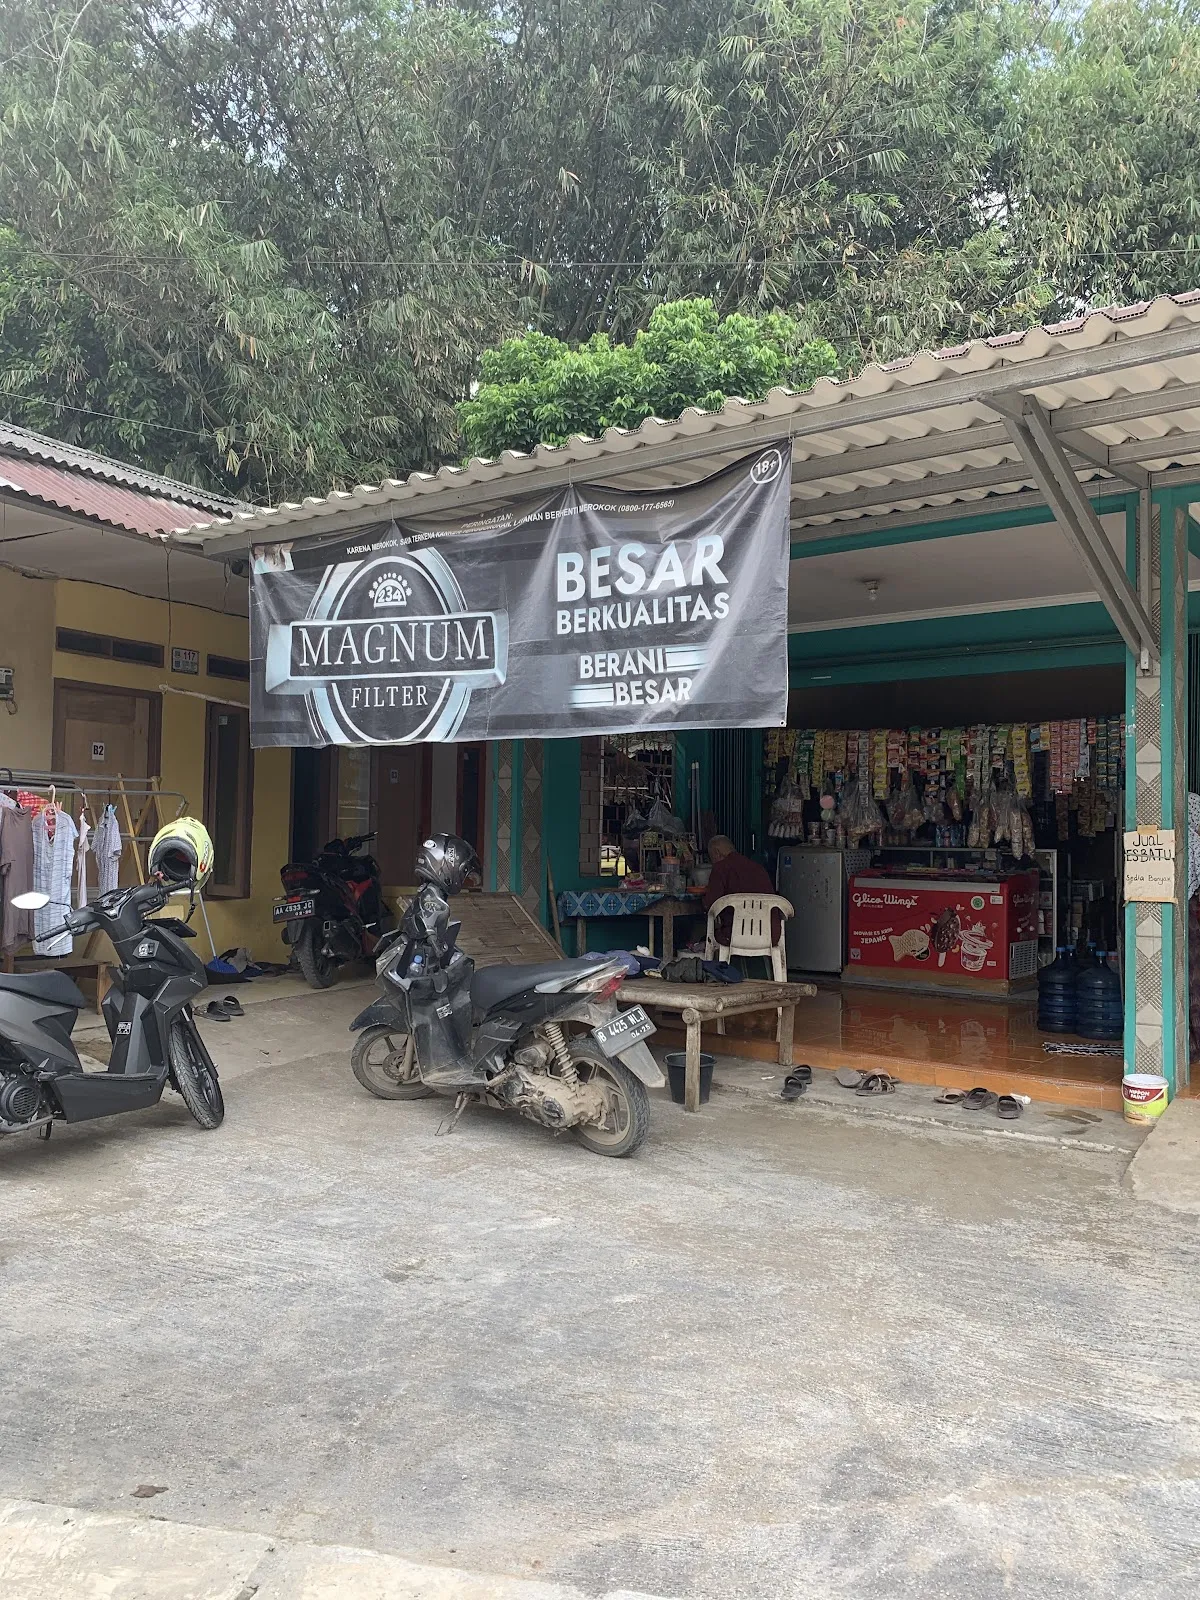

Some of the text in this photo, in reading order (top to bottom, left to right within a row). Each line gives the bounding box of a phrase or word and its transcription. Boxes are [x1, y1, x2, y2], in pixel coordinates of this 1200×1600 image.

[755, 459, 777, 476] 18+
[545, 506, 578, 520] BERHENTI
[618, 499, 675, 513] (0800-177-6565)
[346, 545, 372, 555] KARENA
[412, 532, 435, 542] TERKENA
[557, 534, 729, 602] BESAR
[378, 586, 402, 603] 234
[556, 592, 730, 635] BERKUALITAS
[299, 619, 490, 667] MAGNUM
[184, 651, 196, 661] 117
[580, 648, 665, 679] BERANI
[351, 685, 429, 709] FILTER
[613, 677, 693, 706] BESAR
[93, 745, 104, 756] B2
[1126, 873, 1145, 882] Sedia
[852, 892, 918, 909] Glico Wings
[276, 907, 284, 915] AA
[861, 935, 886, 944] JEPANG
[597, 1031, 608, 1043] B
[608, 1019, 628, 1036] 4425
[1129, 1089, 1150, 1097] NIPPON
